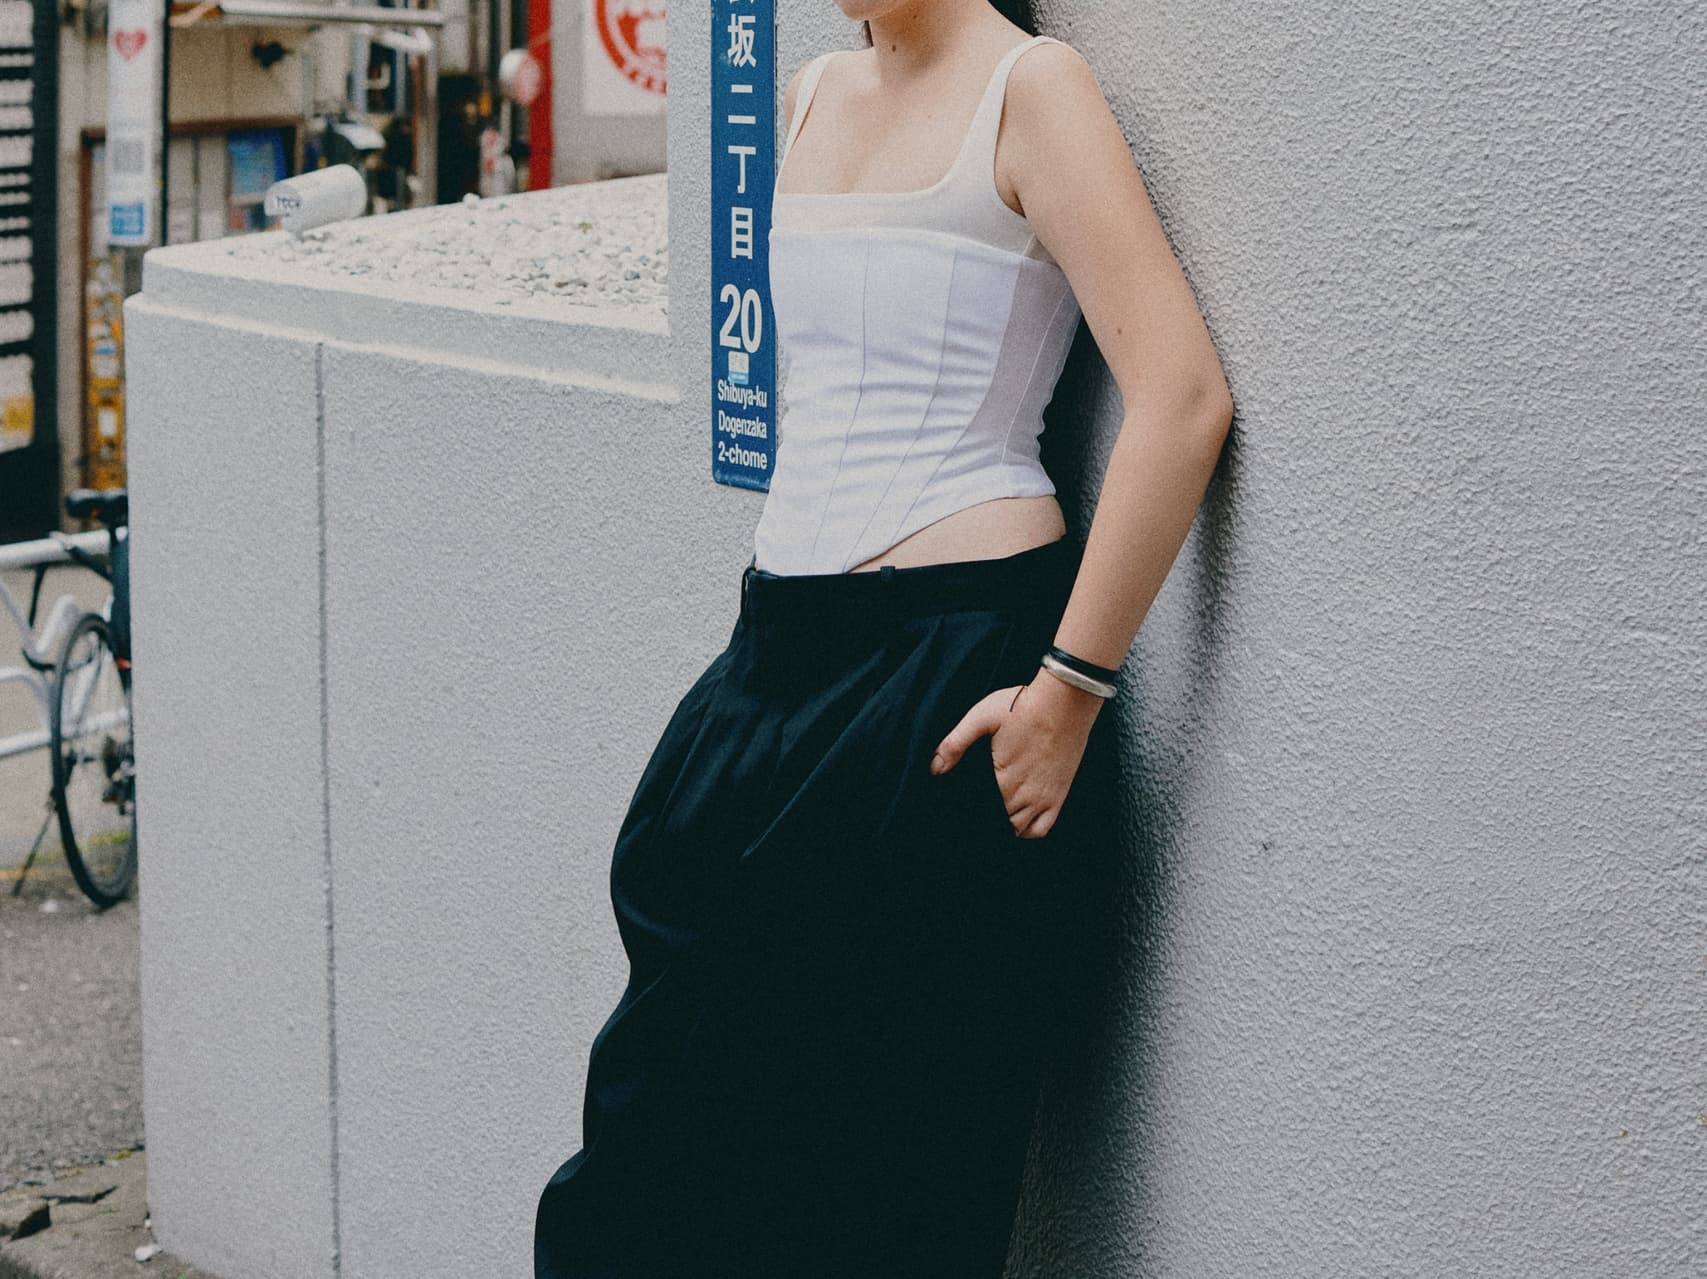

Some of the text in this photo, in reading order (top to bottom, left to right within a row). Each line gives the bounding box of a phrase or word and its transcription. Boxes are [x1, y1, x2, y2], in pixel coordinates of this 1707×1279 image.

[719, 284, 762, 353] 20
[718, 379, 767, 410] Shibuya-ku
[718, 410, 767, 439] Dogenzaka
[718, 441, 768, 470] 2-chome
